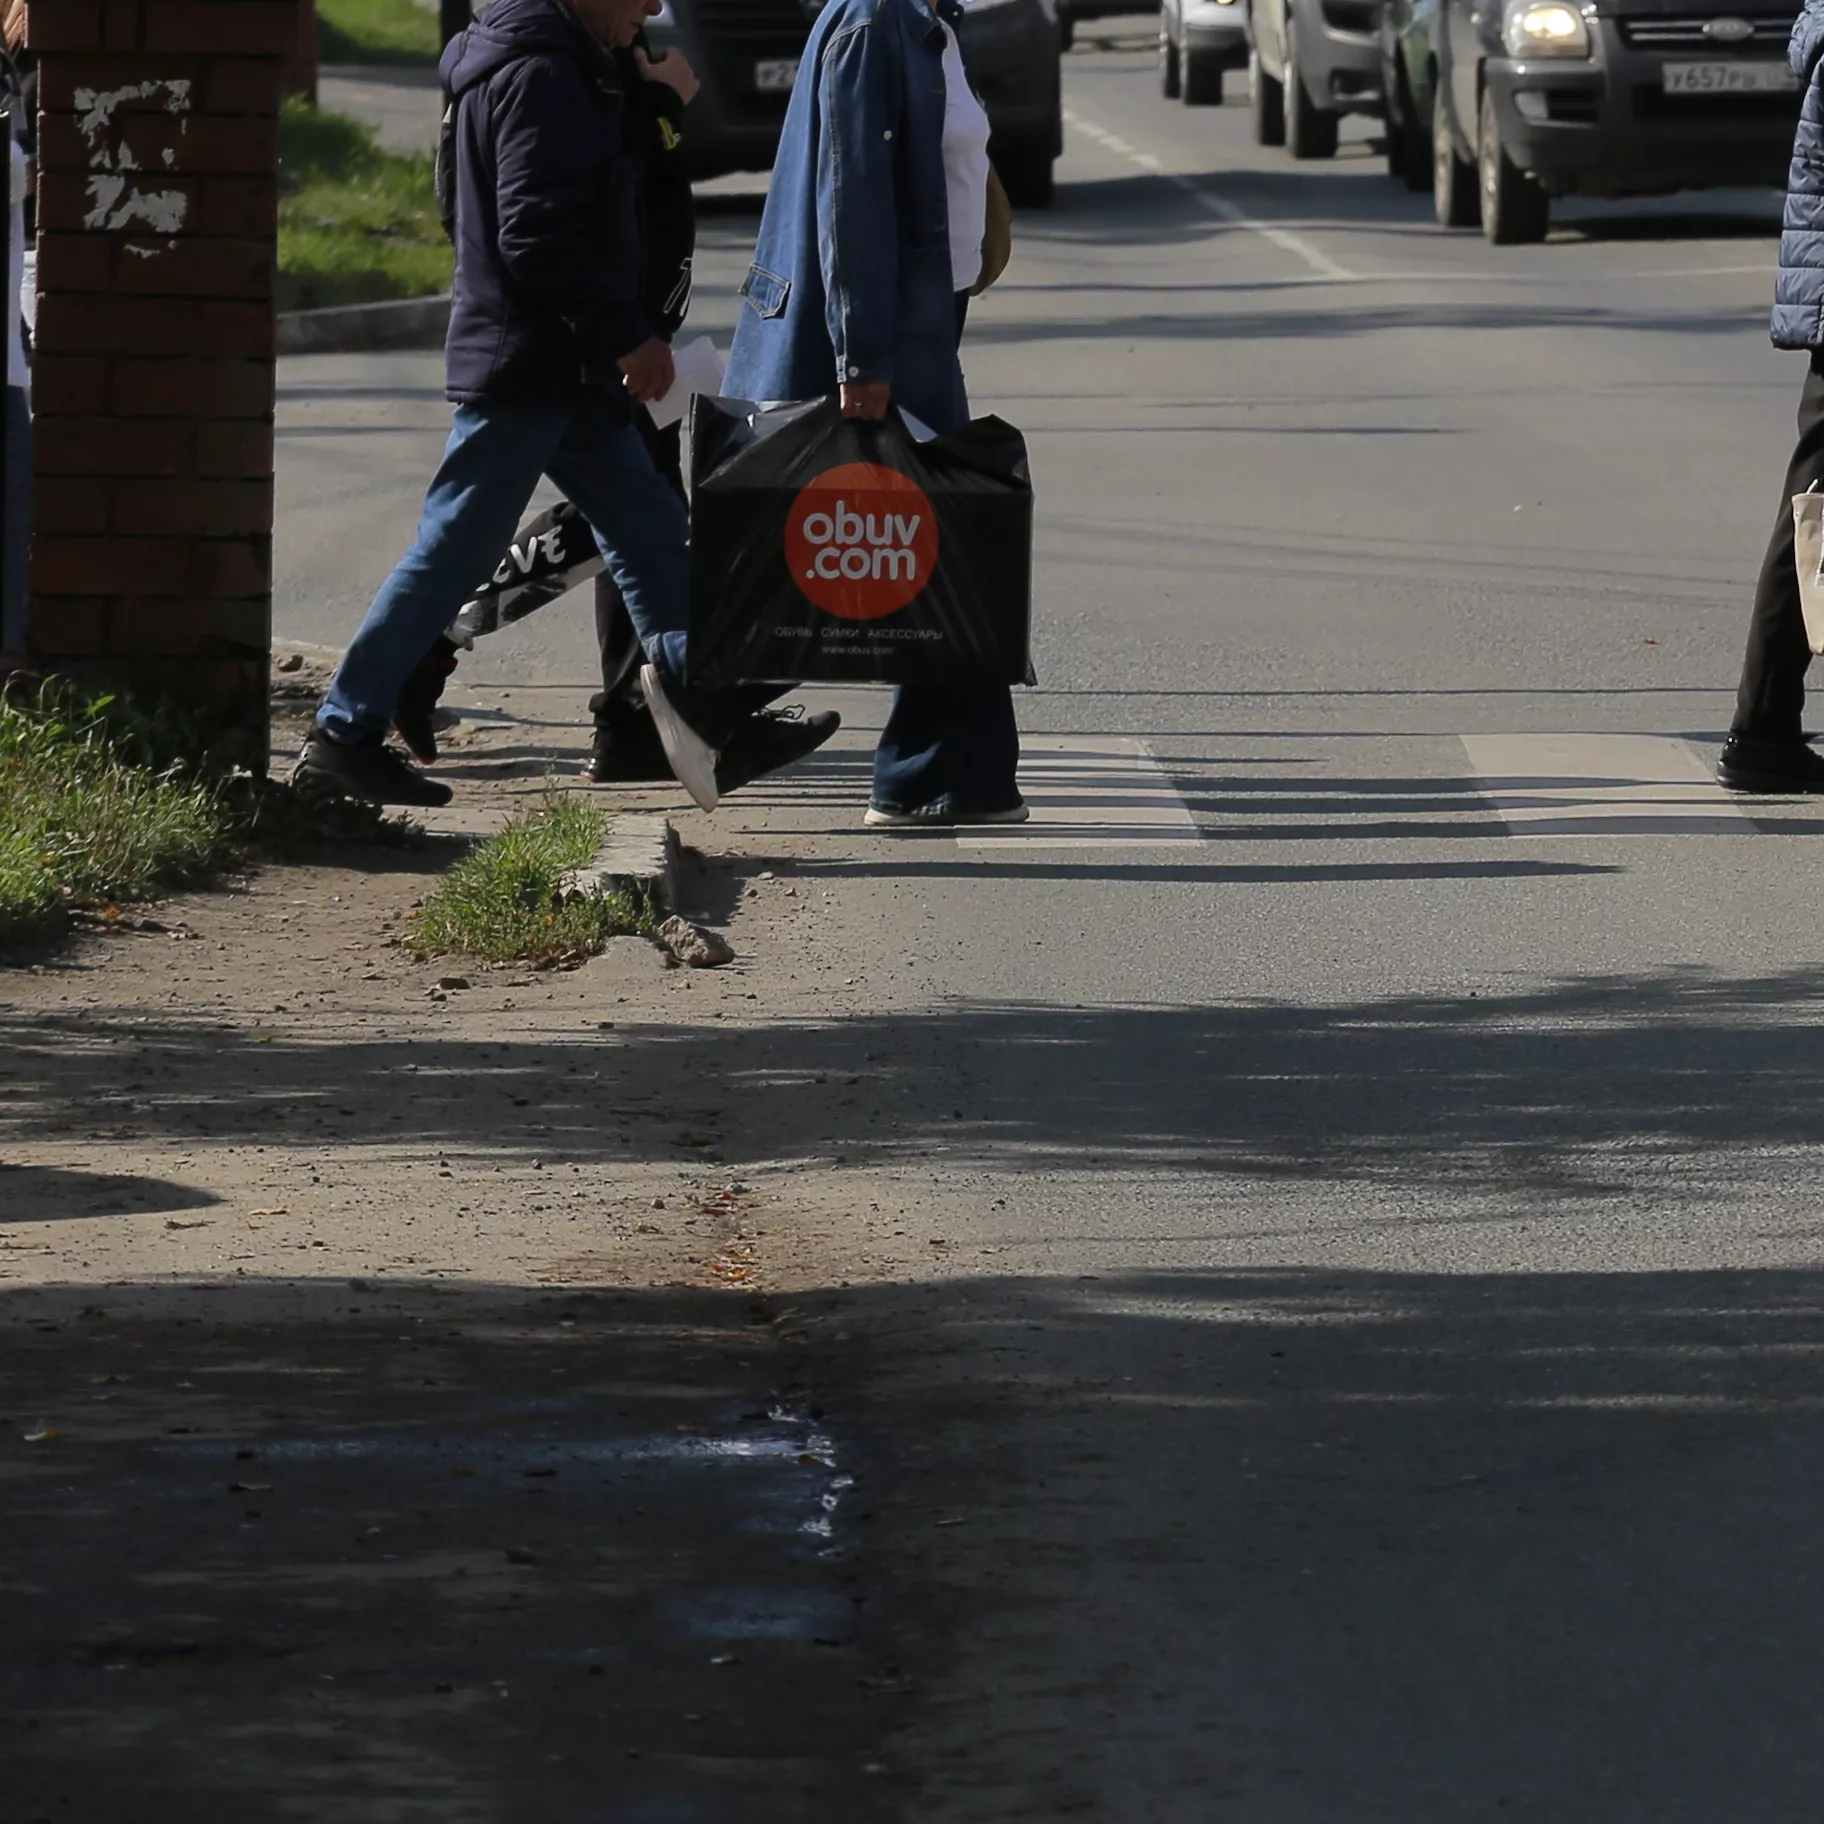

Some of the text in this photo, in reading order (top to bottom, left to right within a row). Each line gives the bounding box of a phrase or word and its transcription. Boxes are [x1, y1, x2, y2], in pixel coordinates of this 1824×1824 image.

[803, 500, 921, 546] obuv
[805, 547, 916, 581] .com
[774, 627, 943, 640] ОБУВЬ СУМКИ АКСЕССУАРЫ
